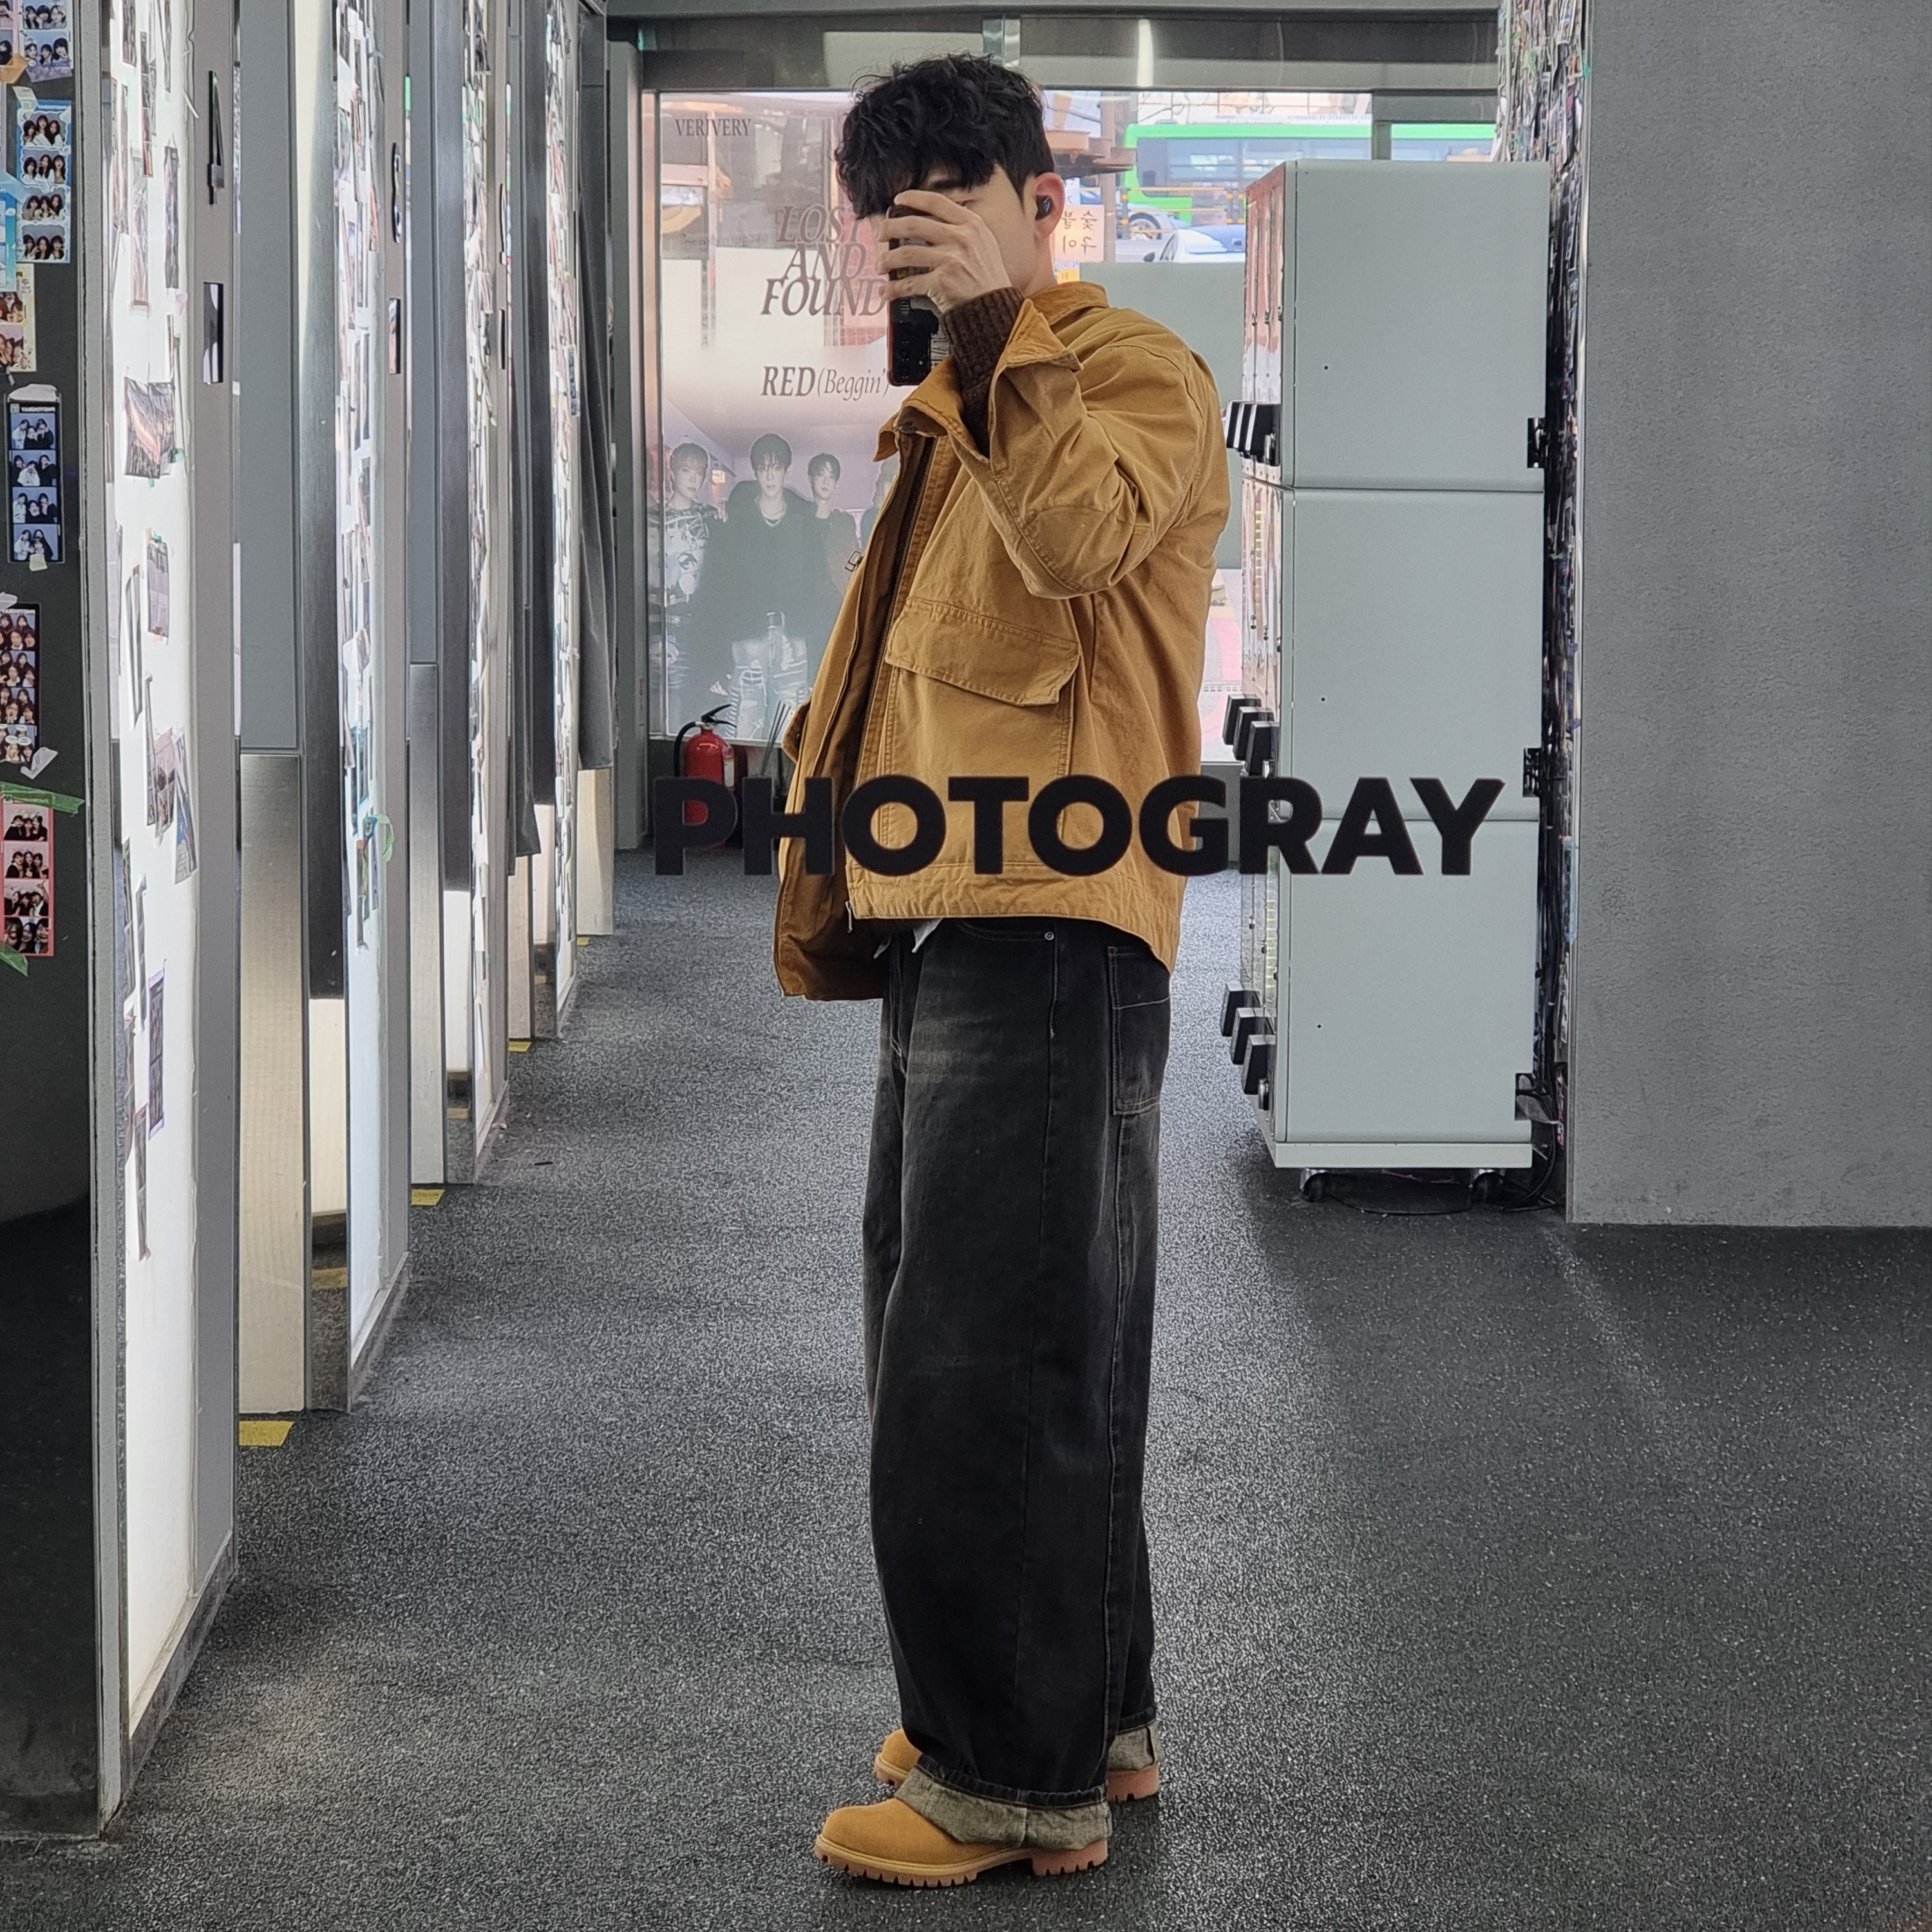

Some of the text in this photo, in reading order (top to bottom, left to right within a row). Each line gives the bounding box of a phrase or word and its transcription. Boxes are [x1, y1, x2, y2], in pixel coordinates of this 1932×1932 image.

[676, 118, 752, 137] VERIVERY
[784, 243, 867, 281] AND
[760, 278, 888, 316] FOUND
[761, 366, 815, 396] RED
[654, 775, 1506, 876] PHOTOGRAY
